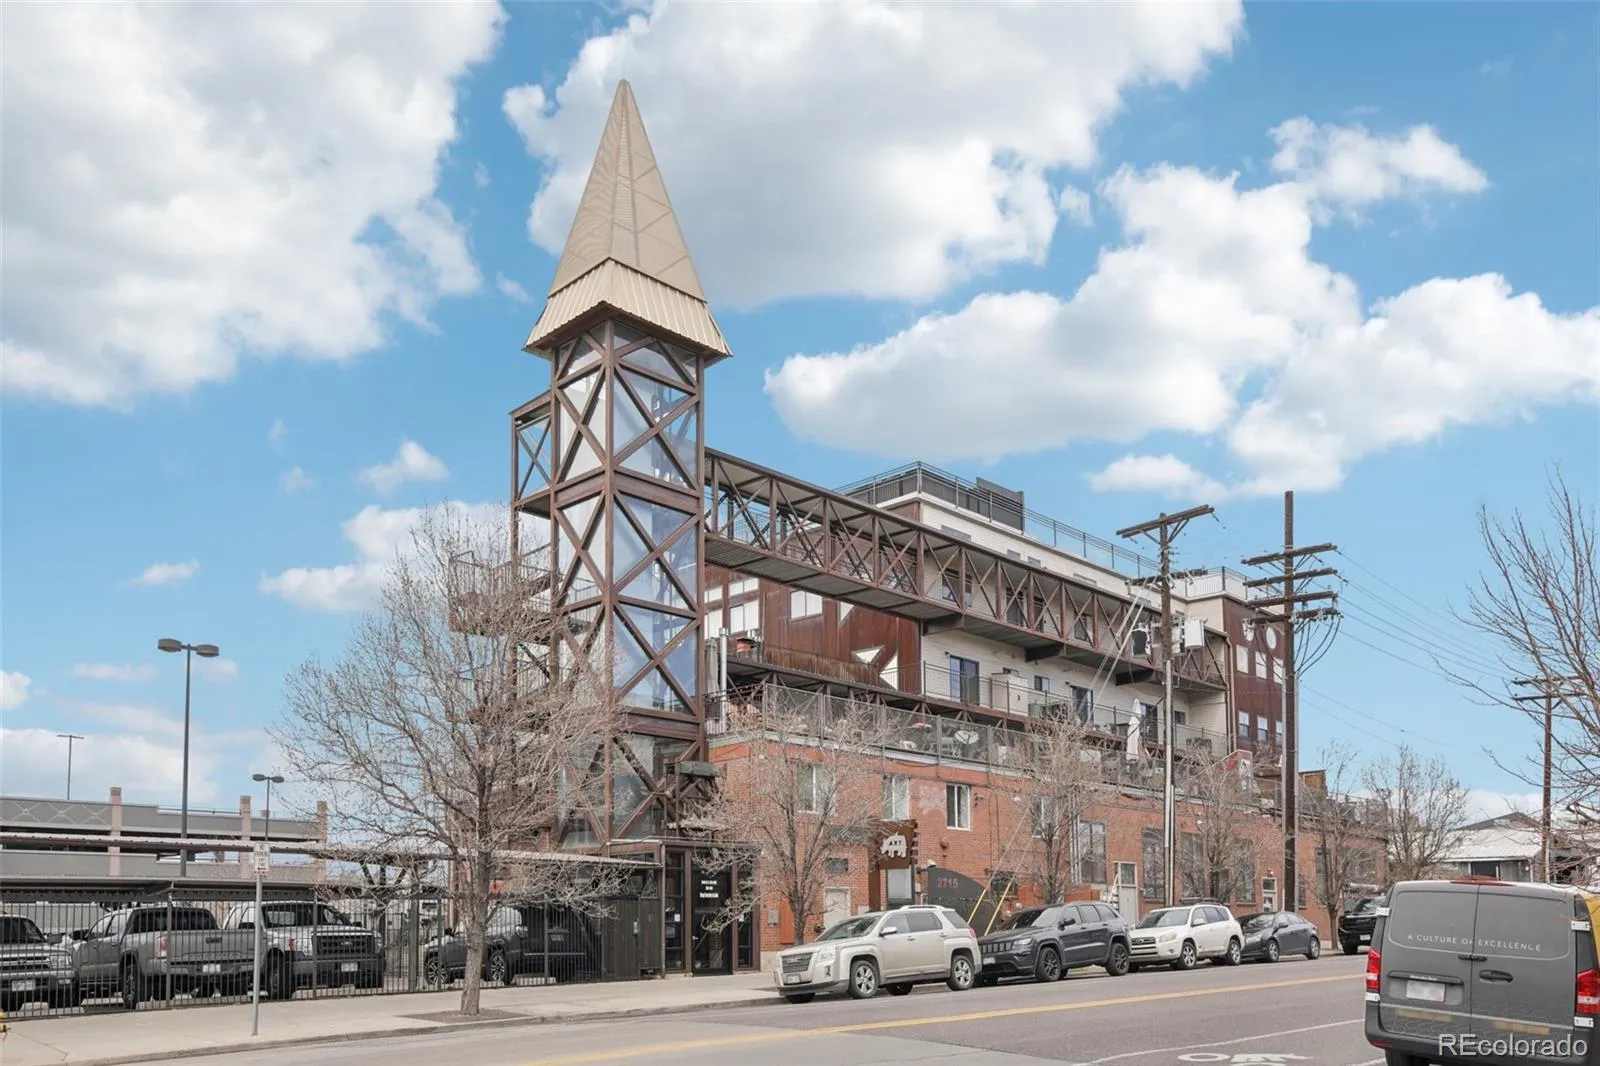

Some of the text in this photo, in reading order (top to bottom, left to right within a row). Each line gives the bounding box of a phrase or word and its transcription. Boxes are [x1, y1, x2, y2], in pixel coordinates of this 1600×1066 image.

[1407, 933, 1413, 941] A
[1416, 934, 1458, 945] CULTURE
[1478, 938, 1541, 952] EXCELLENCE
